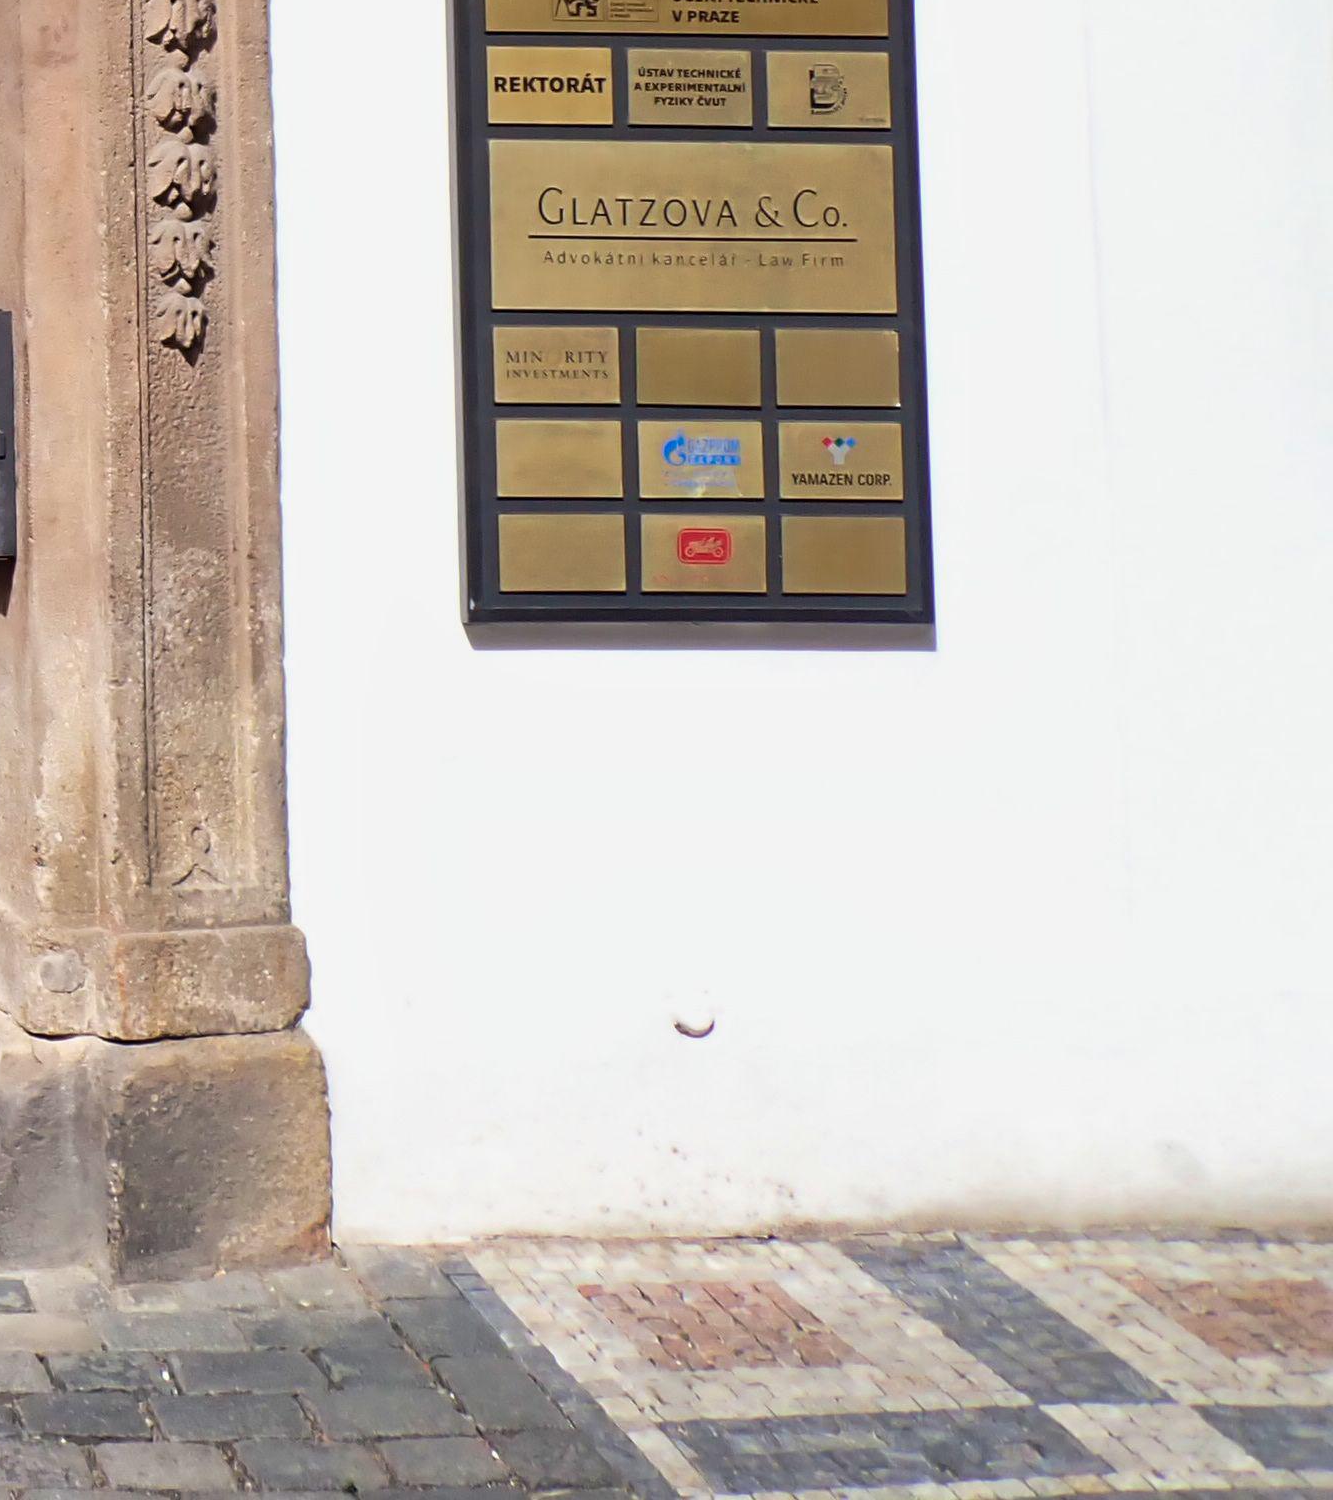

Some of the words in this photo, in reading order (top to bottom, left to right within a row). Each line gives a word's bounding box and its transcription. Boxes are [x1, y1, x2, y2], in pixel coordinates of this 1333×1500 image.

[672, 11, 683, 23] V
[688, 11, 740, 23] PRAZE
[638, 67, 674, 77] ÚSTAV
[677, 68, 742, 79] TECHNICKÉ
[493, 73, 607, 93] REKTORÁT
[634, 83, 642, 91] A
[654, 97, 693, 106] FYZIKY
[697, 95, 726, 107] ČVUT
[538, 187, 738, 228] GLATZOVA
[755, 195, 784, 228] &
[543, 250, 644, 266] Advokátní
[652, 252, 736, 267] kancelář
[759, 253, 793, 267] Law
[802, 252, 845, 267] Firm
[506, 350, 608, 363] MINRITY
[506, 369, 609, 379] INVESTMENTS
[792, 473, 853, 486] YAMAZEN
[857, 473, 892, 486] CORP.
